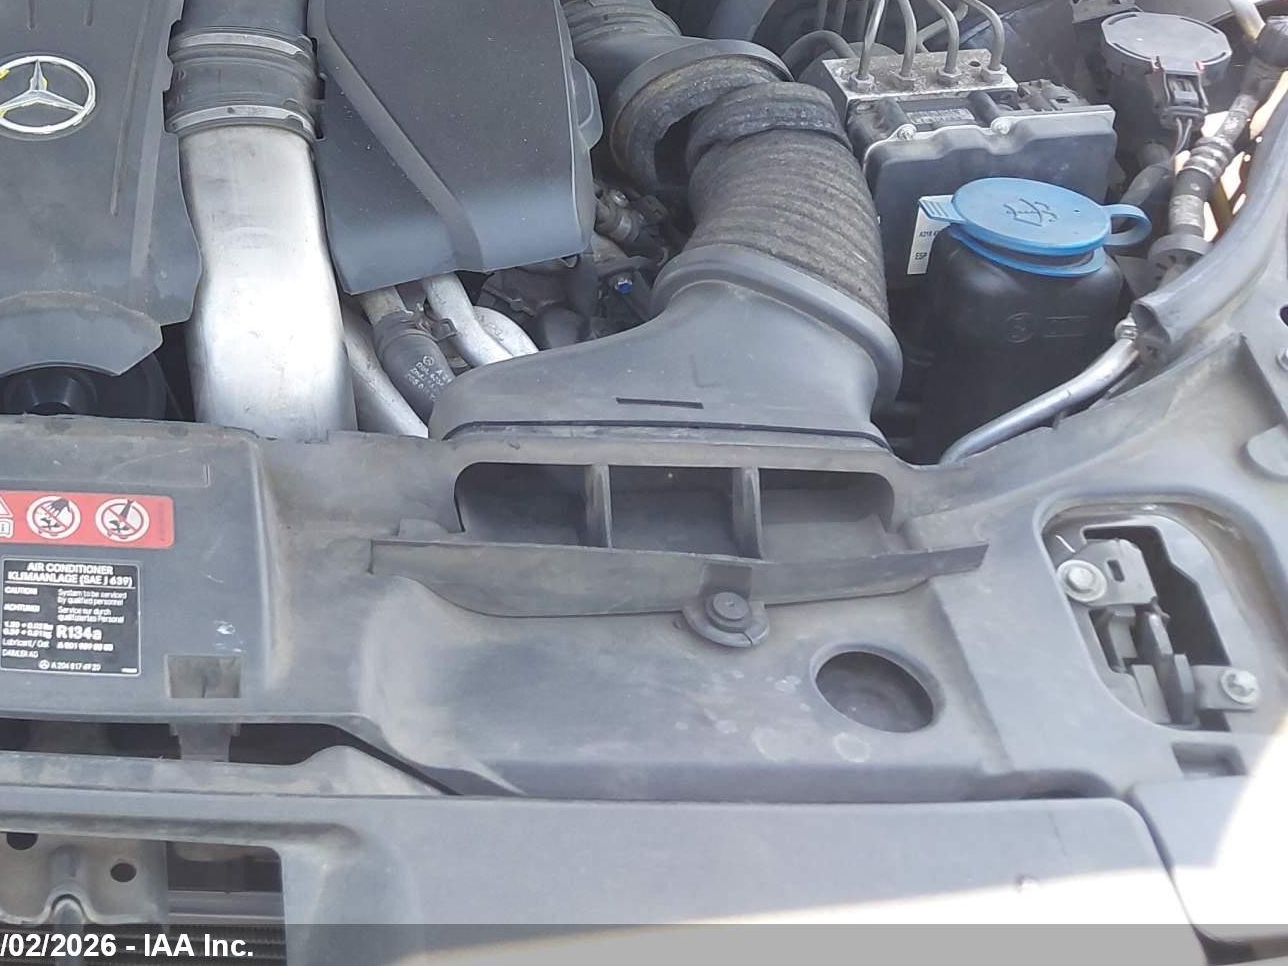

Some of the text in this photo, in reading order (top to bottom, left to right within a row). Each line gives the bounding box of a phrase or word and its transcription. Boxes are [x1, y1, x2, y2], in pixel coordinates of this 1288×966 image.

[26, 561, 114, 575] AIR CONDITIONER
[7, 571, 78, 584] KLIMAANLAGE
[79, 575, 102, 586] (SAE
[109, 576, 133, 587] 639)
[58, 588, 82, 598] System
[57, 606, 82, 614] Service
[93, 608, 111, 616] durch
[98, 615, 124, 623] Personal
[56, 624, 103, 640] R134a
